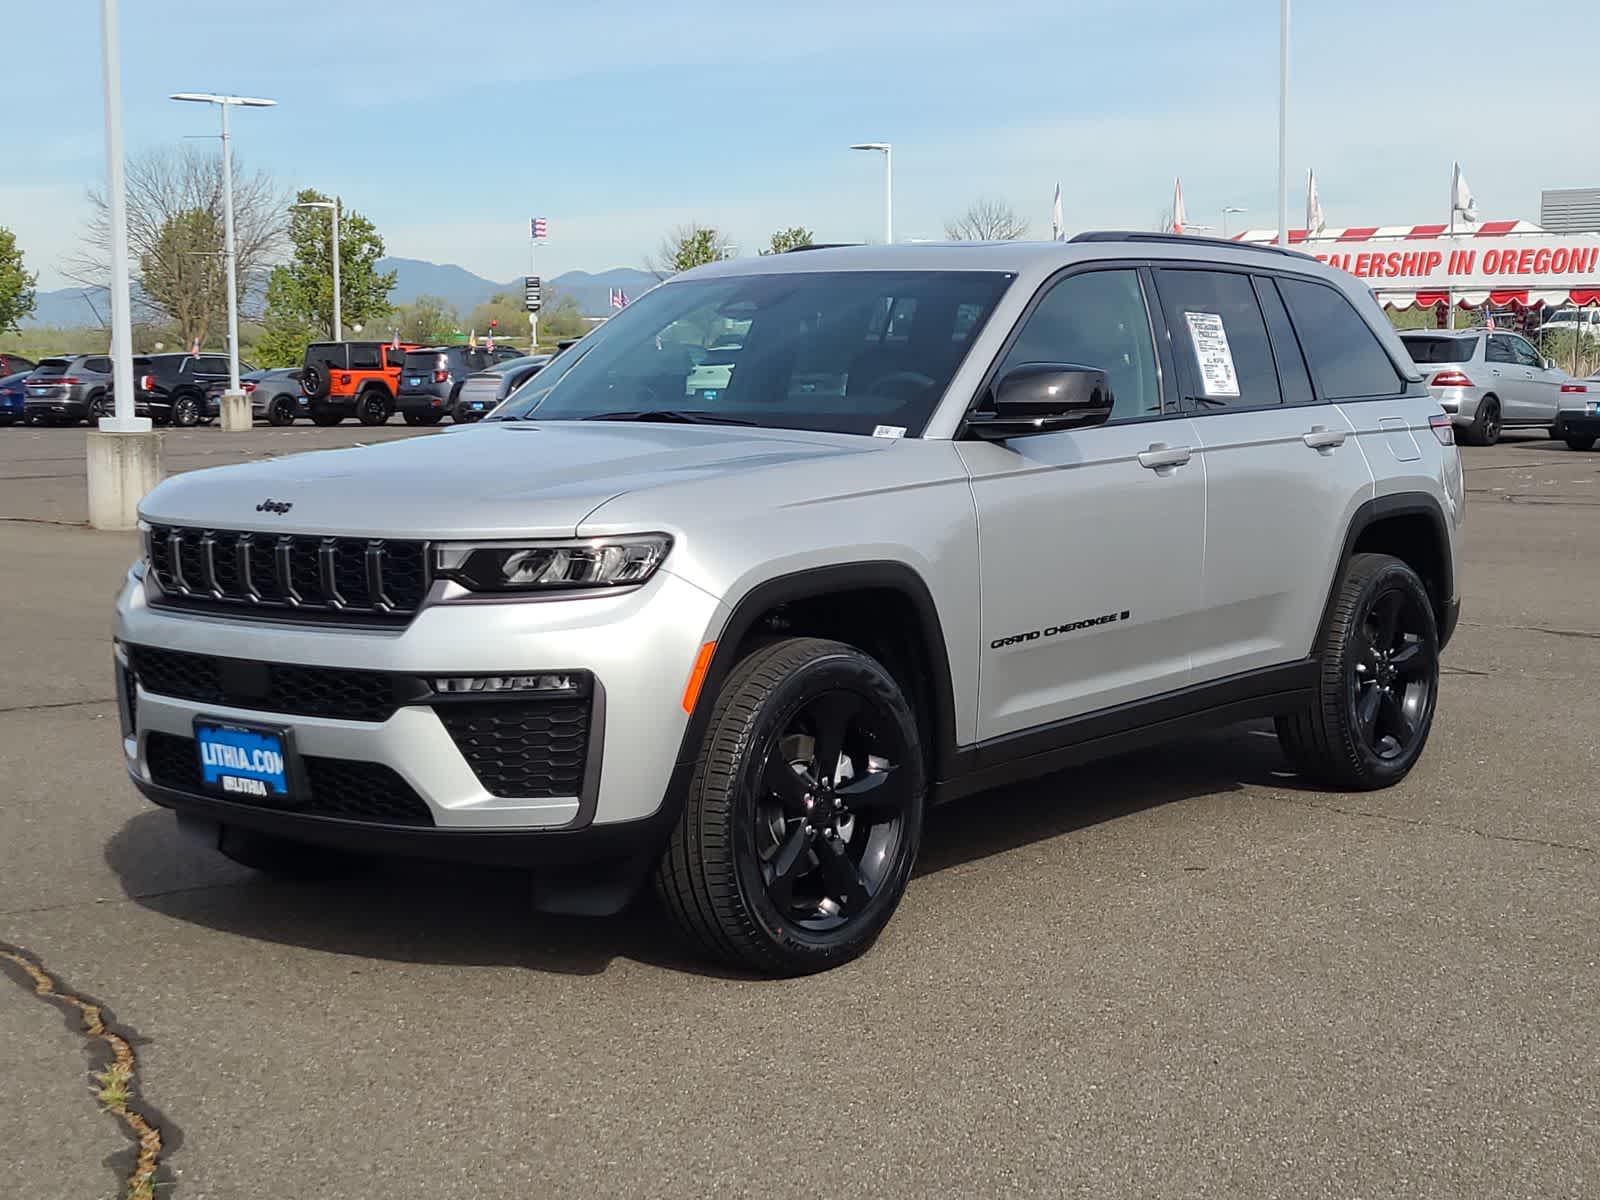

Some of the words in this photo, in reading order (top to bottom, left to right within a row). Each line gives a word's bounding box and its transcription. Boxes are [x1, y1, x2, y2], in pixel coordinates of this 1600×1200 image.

[1447, 250, 1476, 275] IN
[1482, 247, 1599, 275] OREGON!
[256, 498, 293, 516] Jeep
[990, 630, 1041, 649] GRAND
[1043, 612, 1118, 637] CHEROKEE
